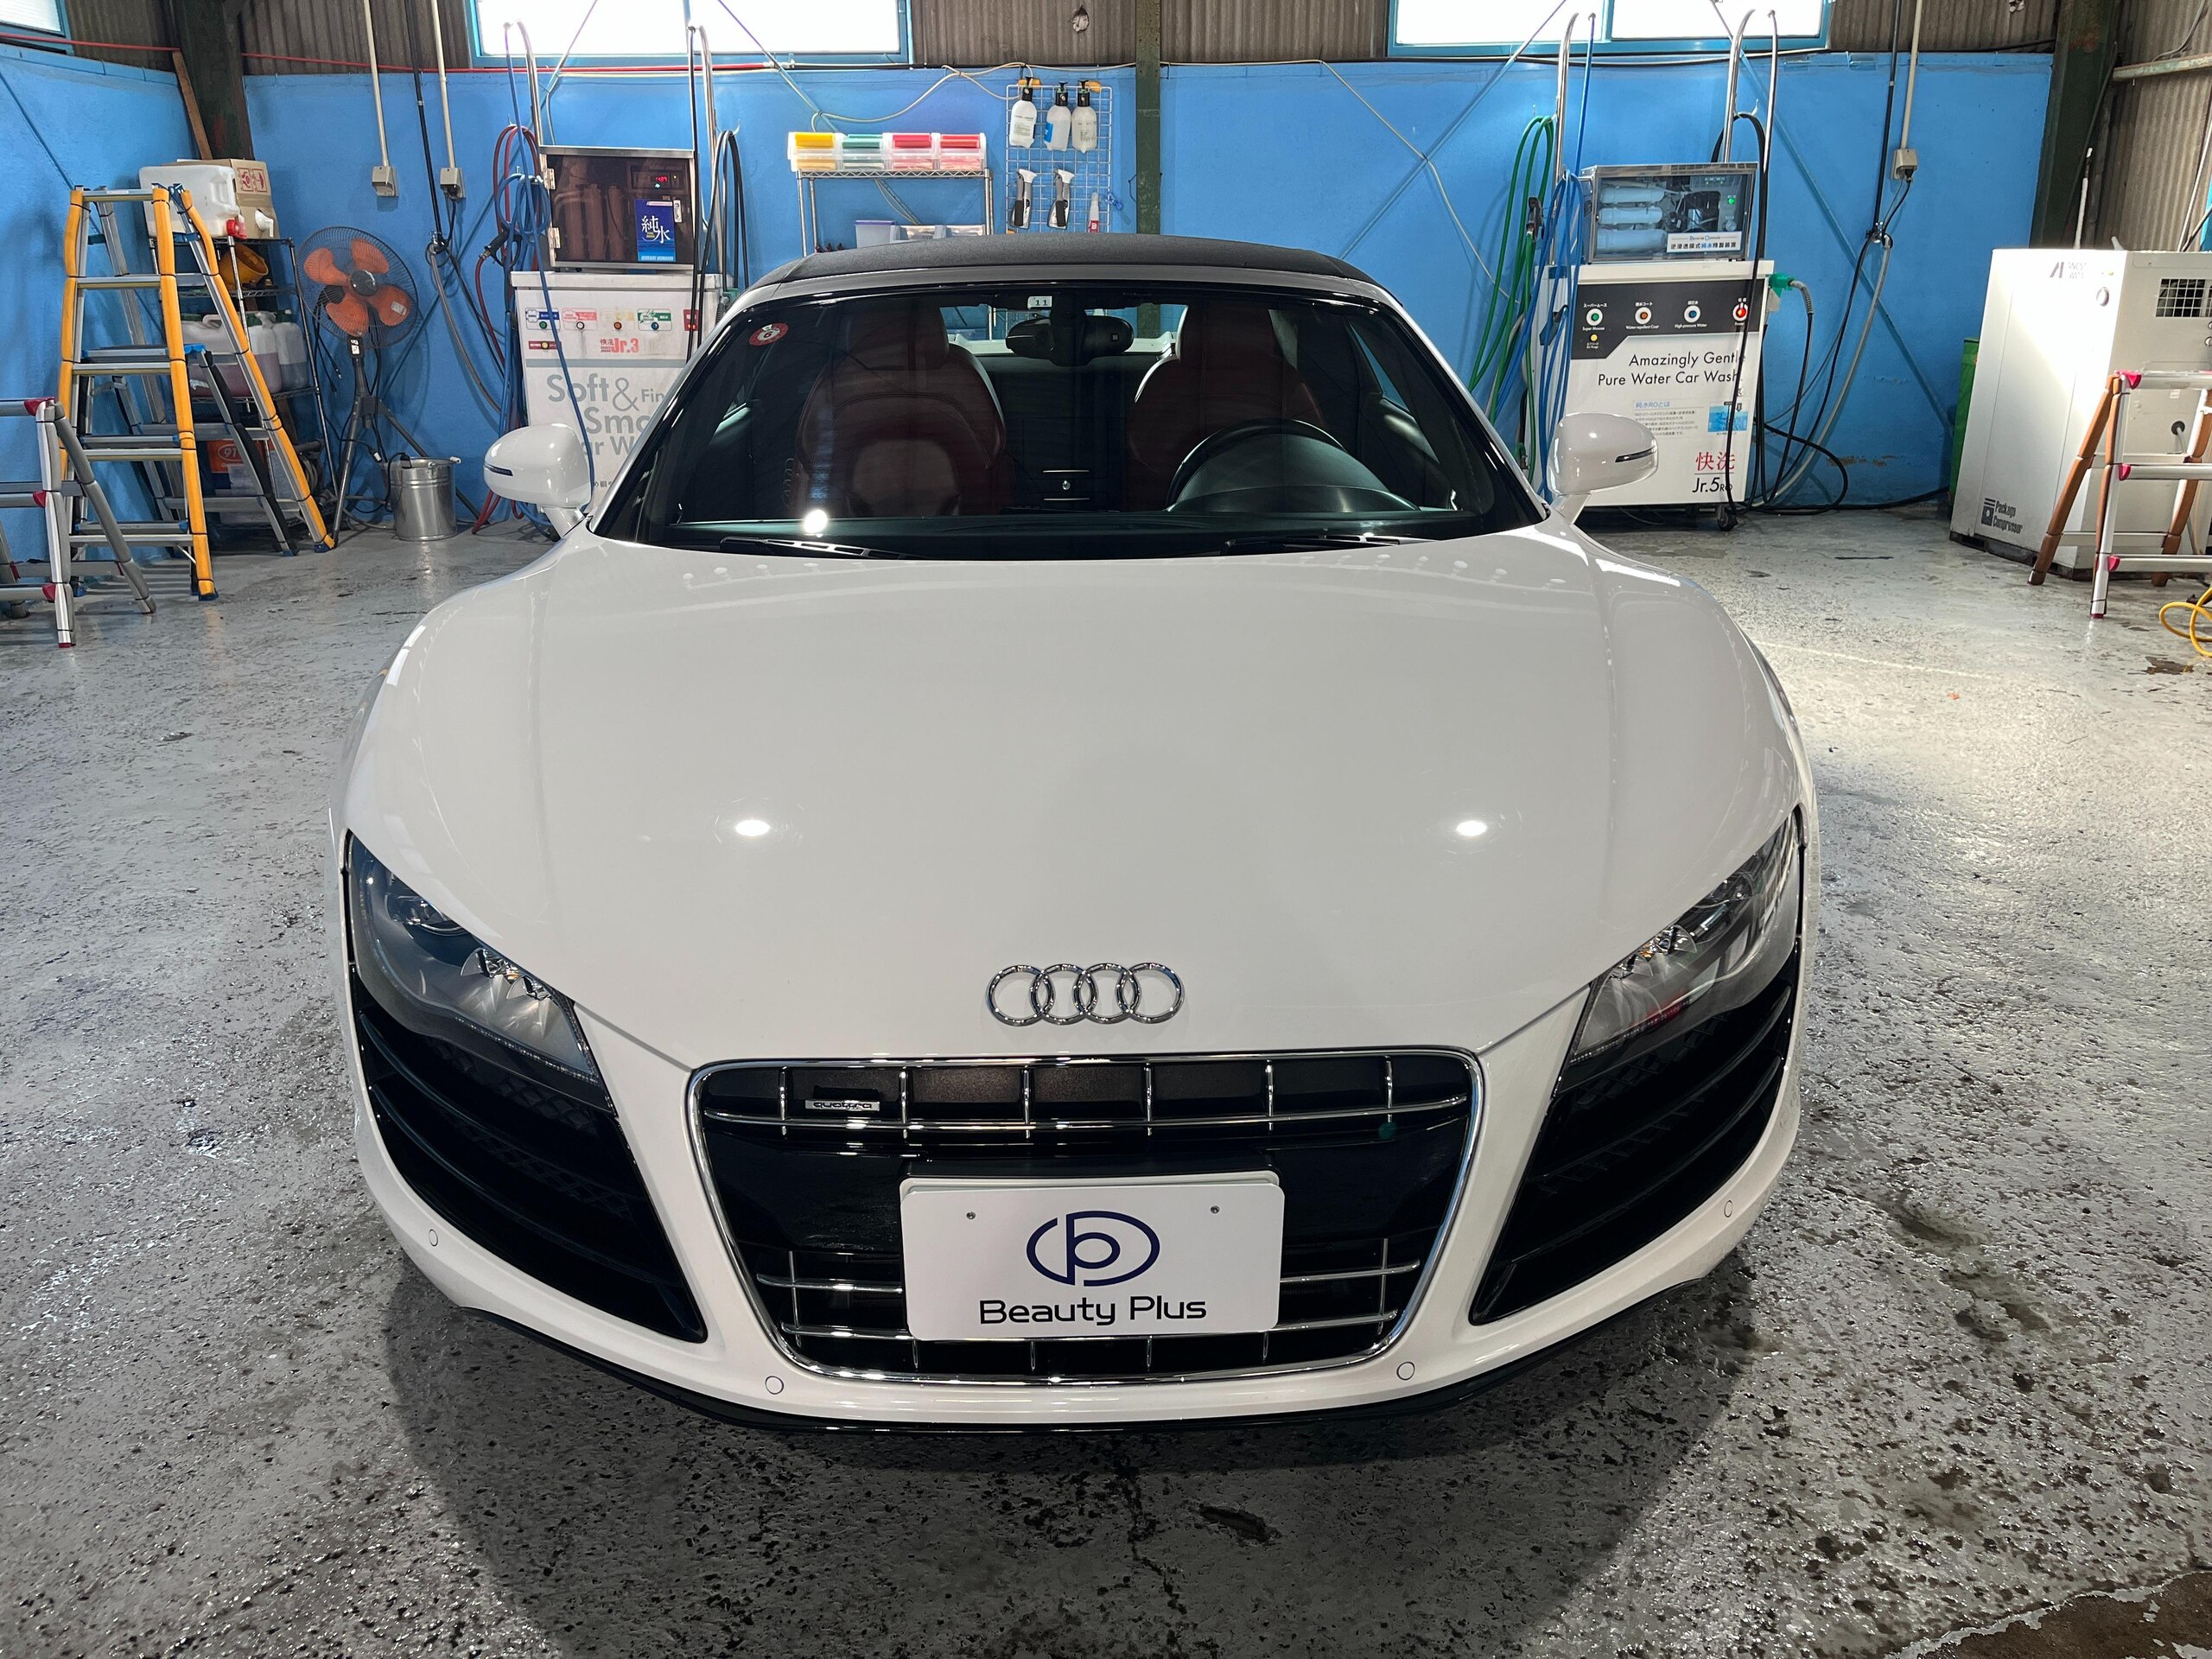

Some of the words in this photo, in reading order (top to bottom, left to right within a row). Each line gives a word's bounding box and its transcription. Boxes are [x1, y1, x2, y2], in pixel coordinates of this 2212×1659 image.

[641, 215, 671, 245] 純水
[612, 338, 639, 353] Jr.3
[1629, 351, 1700, 369] Amazingly
[546, 373, 608, 403] Soft
[641, 389, 664, 403] Fin
[1599, 373, 1626, 386] Pure
[1631, 372, 1670, 385] Water
[1675, 371, 1700, 385] Car
[584, 406, 651, 434] Smo
[1695, 451, 1736, 472] 快洗
[980, 1297, 1116, 1326] Beauty
[1130, 1295, 1206, 1320] Plus
